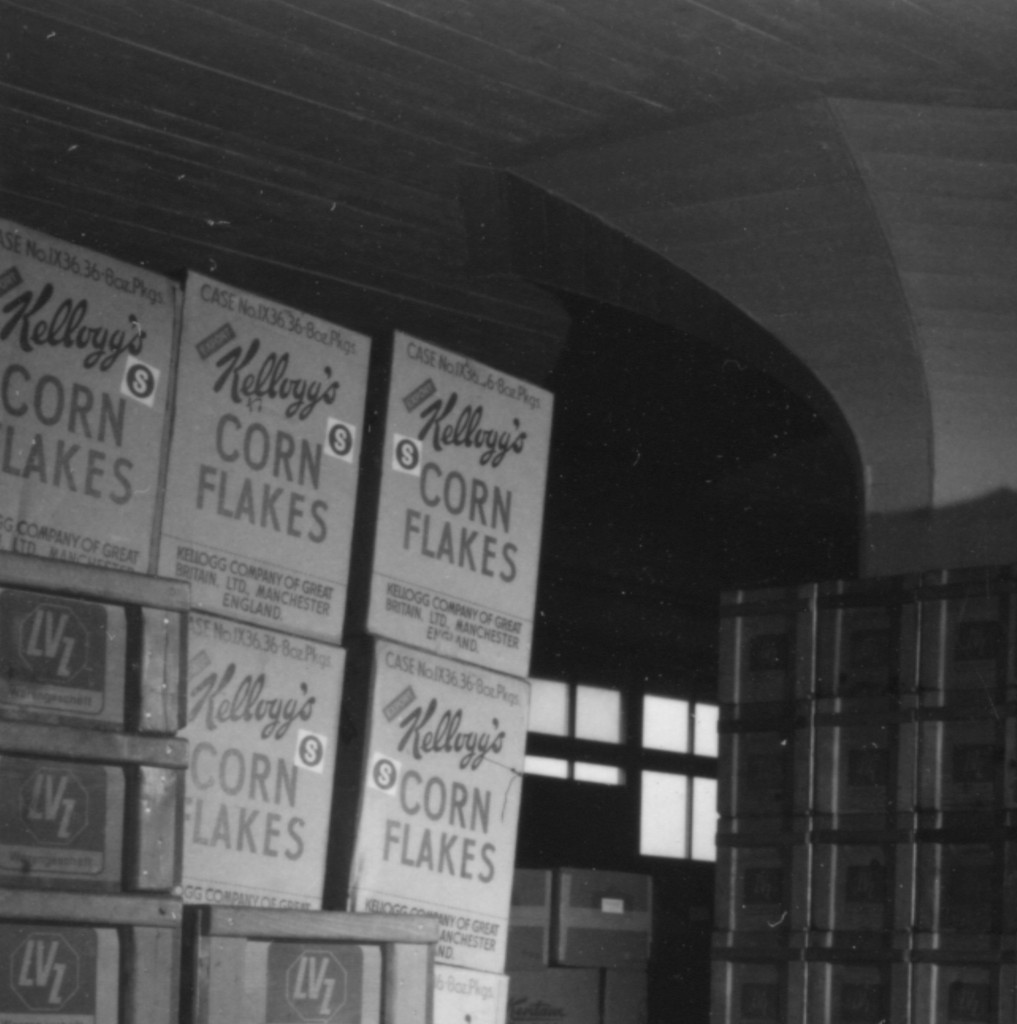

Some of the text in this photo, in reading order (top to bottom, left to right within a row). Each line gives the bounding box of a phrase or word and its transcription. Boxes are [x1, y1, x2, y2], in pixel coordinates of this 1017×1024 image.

[0, 282, 146, 372] Kellogg's
[199, 283, 236, 305] CASE
[213, 337, 341, 421] Kellogg's
[406, 342, 436, 369] CASE
[2, 364, 127, 448] CORN
[417, 392, 528, 469] Kellogg's
[1, 425, 134, 506] LAKES
[215, 413, 323, 491] CORN
[196, 463, 328, 544] FLAKES
[419, 461, 514, 535] CORN
[81, 537, 101, 554] OF
[102, 542, 140, 565] GREAT
[176, 545, 334, 601] KELLOGG COMPANY OF GREAT
[403, 508, 518, 585] FLAKES
[255, 584, 331, 617] MANCHESTER
[386, 582, 524, 636] KELLOGG COMPANY OF GREAT
[27, 609, 75, 677] LVZ
[385, 650, 416, 680] CASE
[455, 619, 520, 651] MANCHESTER
[190, 662, 317, 740] Kellogg's
[397, 698, 506, 771] Kellogg's
[28, 773, 76, 839] LVZ
[190, 741, 299, 808] CORN
[400, 769, 492, 834] CORN
[382, 818, 497, 885] FLAKES
[440, 929, 496, 953] ANCHESTER
[457, 916, 471, 931] OF
[471, 919, 501, 937] GREAT
[18, 940, 66, 1004] LVZ
[293, 956, 336, 1016] LVZ
